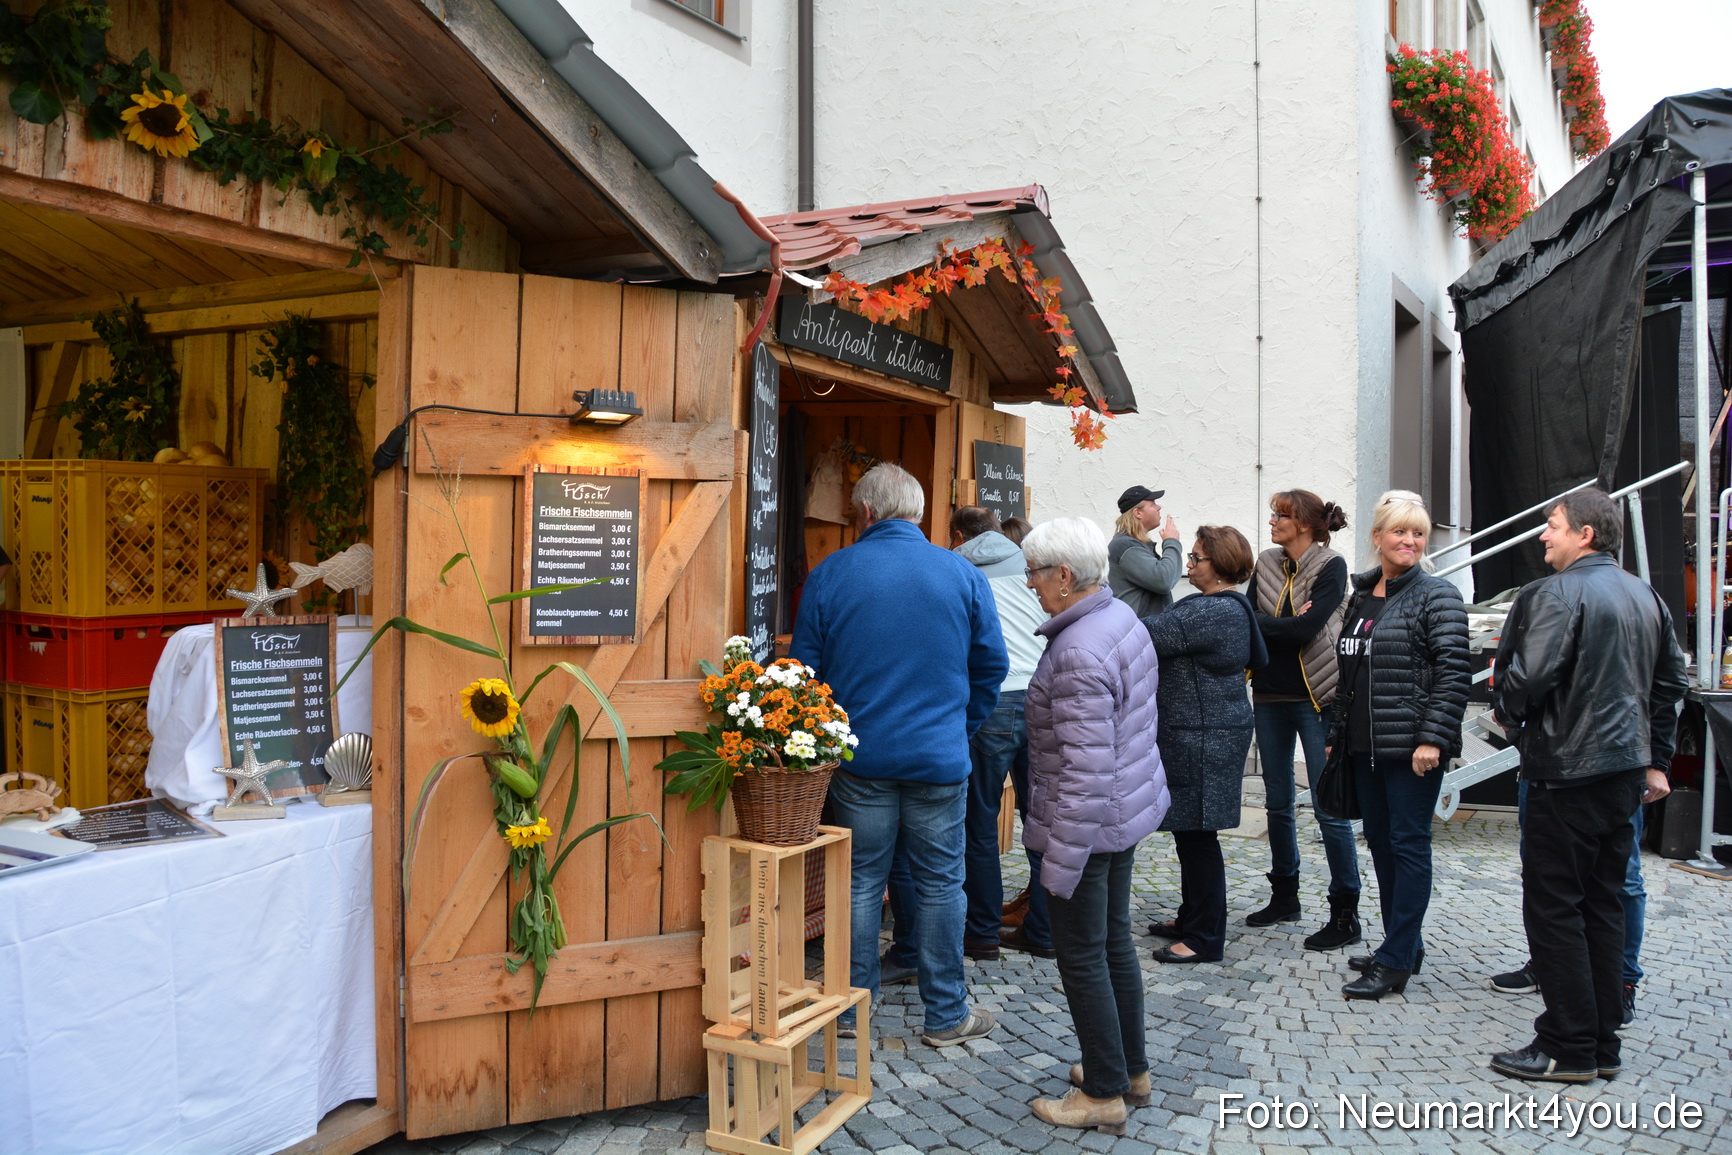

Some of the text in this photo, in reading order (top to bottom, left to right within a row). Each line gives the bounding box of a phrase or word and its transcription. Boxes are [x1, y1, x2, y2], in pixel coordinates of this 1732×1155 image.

[793, 302, 944, 380] Antipasti italiani
[540, 505, 632, 519] Frische Fischsemmeln
[539, 522, 595, 532] Bismarcksemmel
[611, 525, 626, 534] 3,00
[538, 535, 631, 546] Lachsersatzsemmel 3,00 €
[538, 548, 631, 559] Bratheringssemmel 3,00 €
[538, 561, 585, 571] Matjessemmel
[610, 563, 624, 572] 3,50
[538, 576, 556, 584] Echte
[610, 577, 624, 586] 4,50
[536, 609, 628, 618] Knoblauchgarnelen- 4,50 €
[536, 619, 562, 627] semmel
[231, 657, 323, 671] Frische Fischsemmeln
[231, 672, 322, 685] Bismarcksemmel 3,00 €
[232, 687, 295, 698] Lachsersatzsemmel
[304, 685, 317, 694] 3,00
[233, 700, 295, 711] Bratheringssemmel
[304, 698, 318, 707] 3,00
[234, 710, 324, 725] Matjessemmel 3,50 €
[235, 725, 326, 740] Echte Räucherlachs- 4,50 €
[236, 742, 261, 751] seel
[759, 860, 768, 889] Wein
[758, 917, 768, 978] deutschen
[759, 981, 768, 1025] Landen
